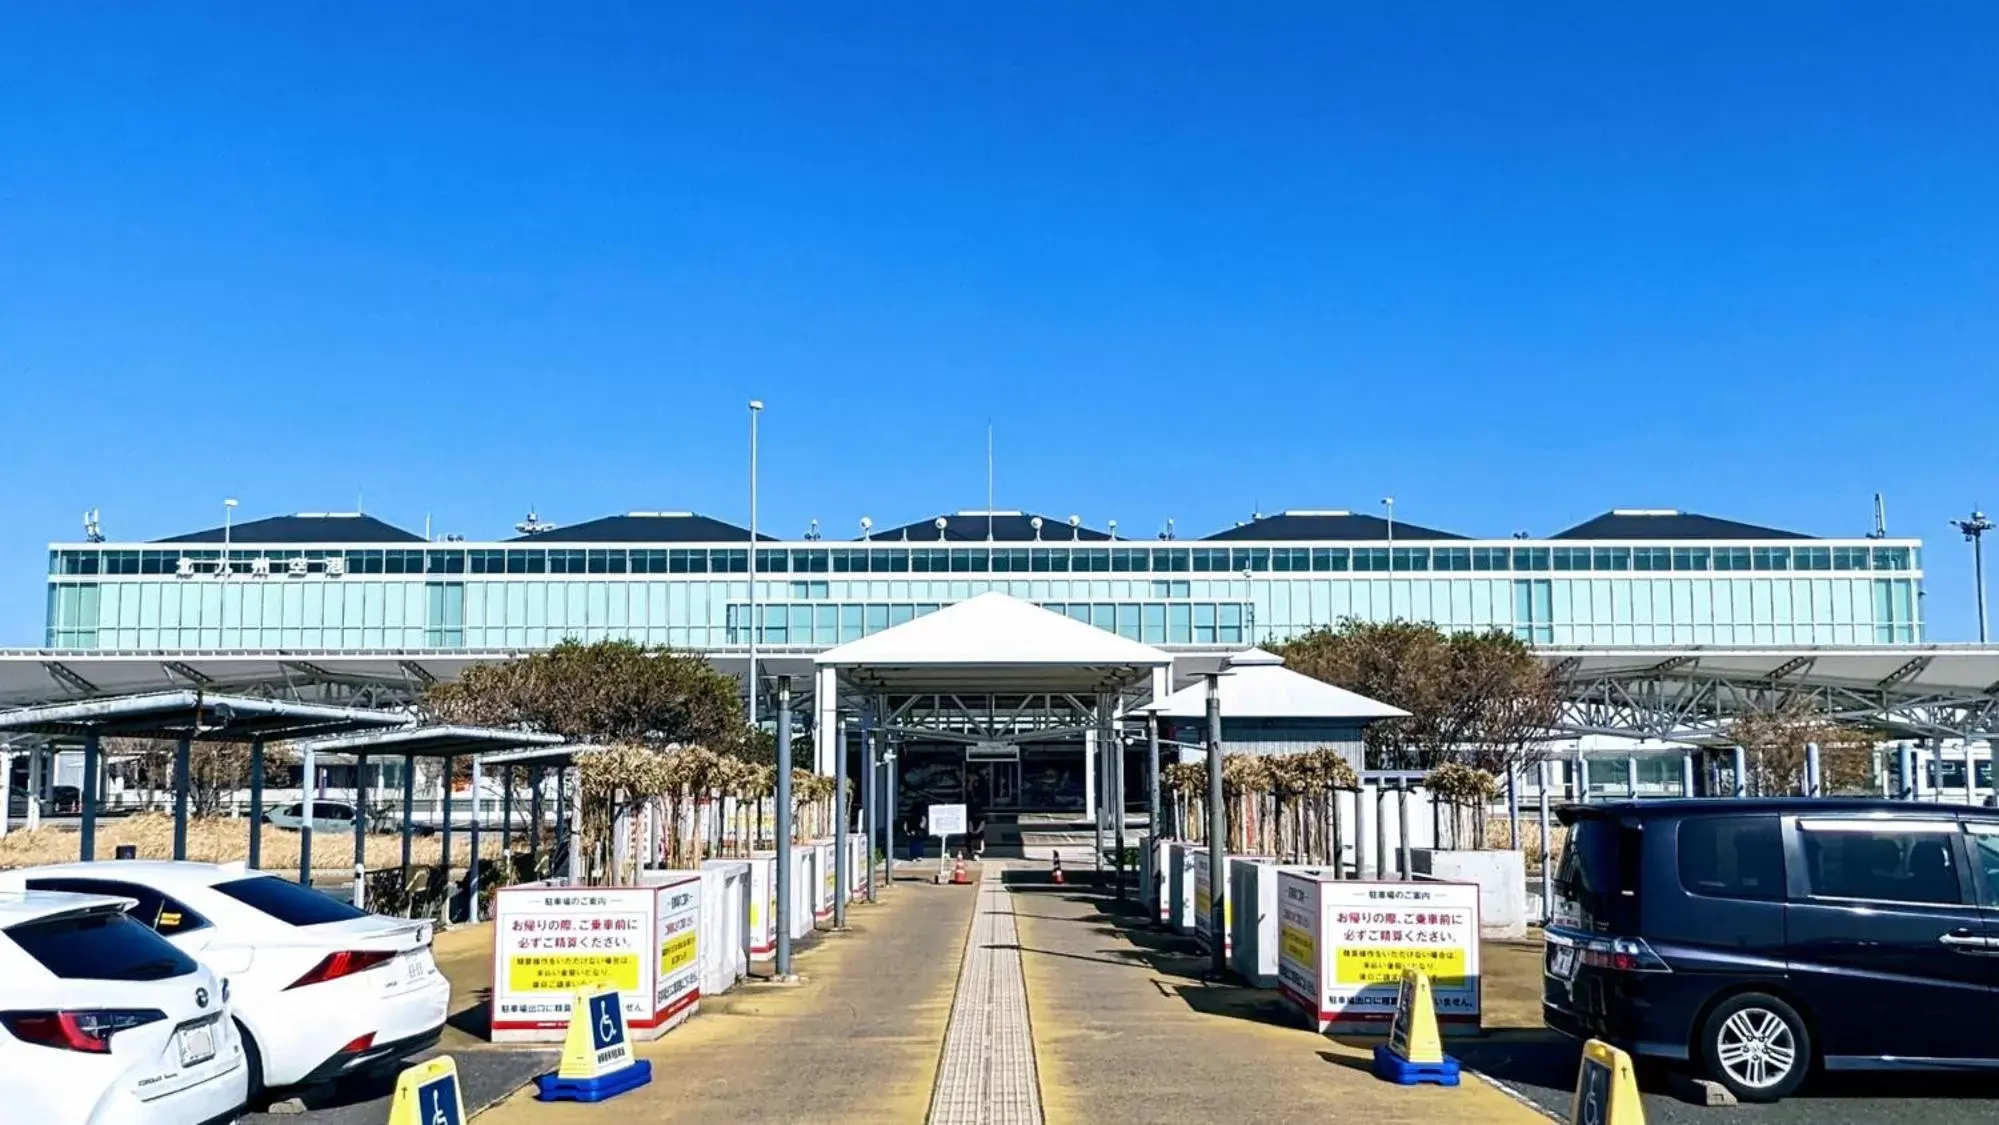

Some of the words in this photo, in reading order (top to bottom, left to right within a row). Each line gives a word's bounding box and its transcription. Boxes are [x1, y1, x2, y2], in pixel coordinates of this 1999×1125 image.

[176, 556, 345, 577] 北九州空港
[1368, 889, 1431, 900] 駐車場のご案内
[545, 897, 607, 907] 駐車場のご案内
[511, 918, 639, 932] お帰りの際、ご乗車前に
[1337, 911, 1464, 926] お帰りの際、ご乗車前に
[517, 936, 632, 949] 必ずご精算ください。
[1343, 928, 1457, 943] 必ずご精算ください。
